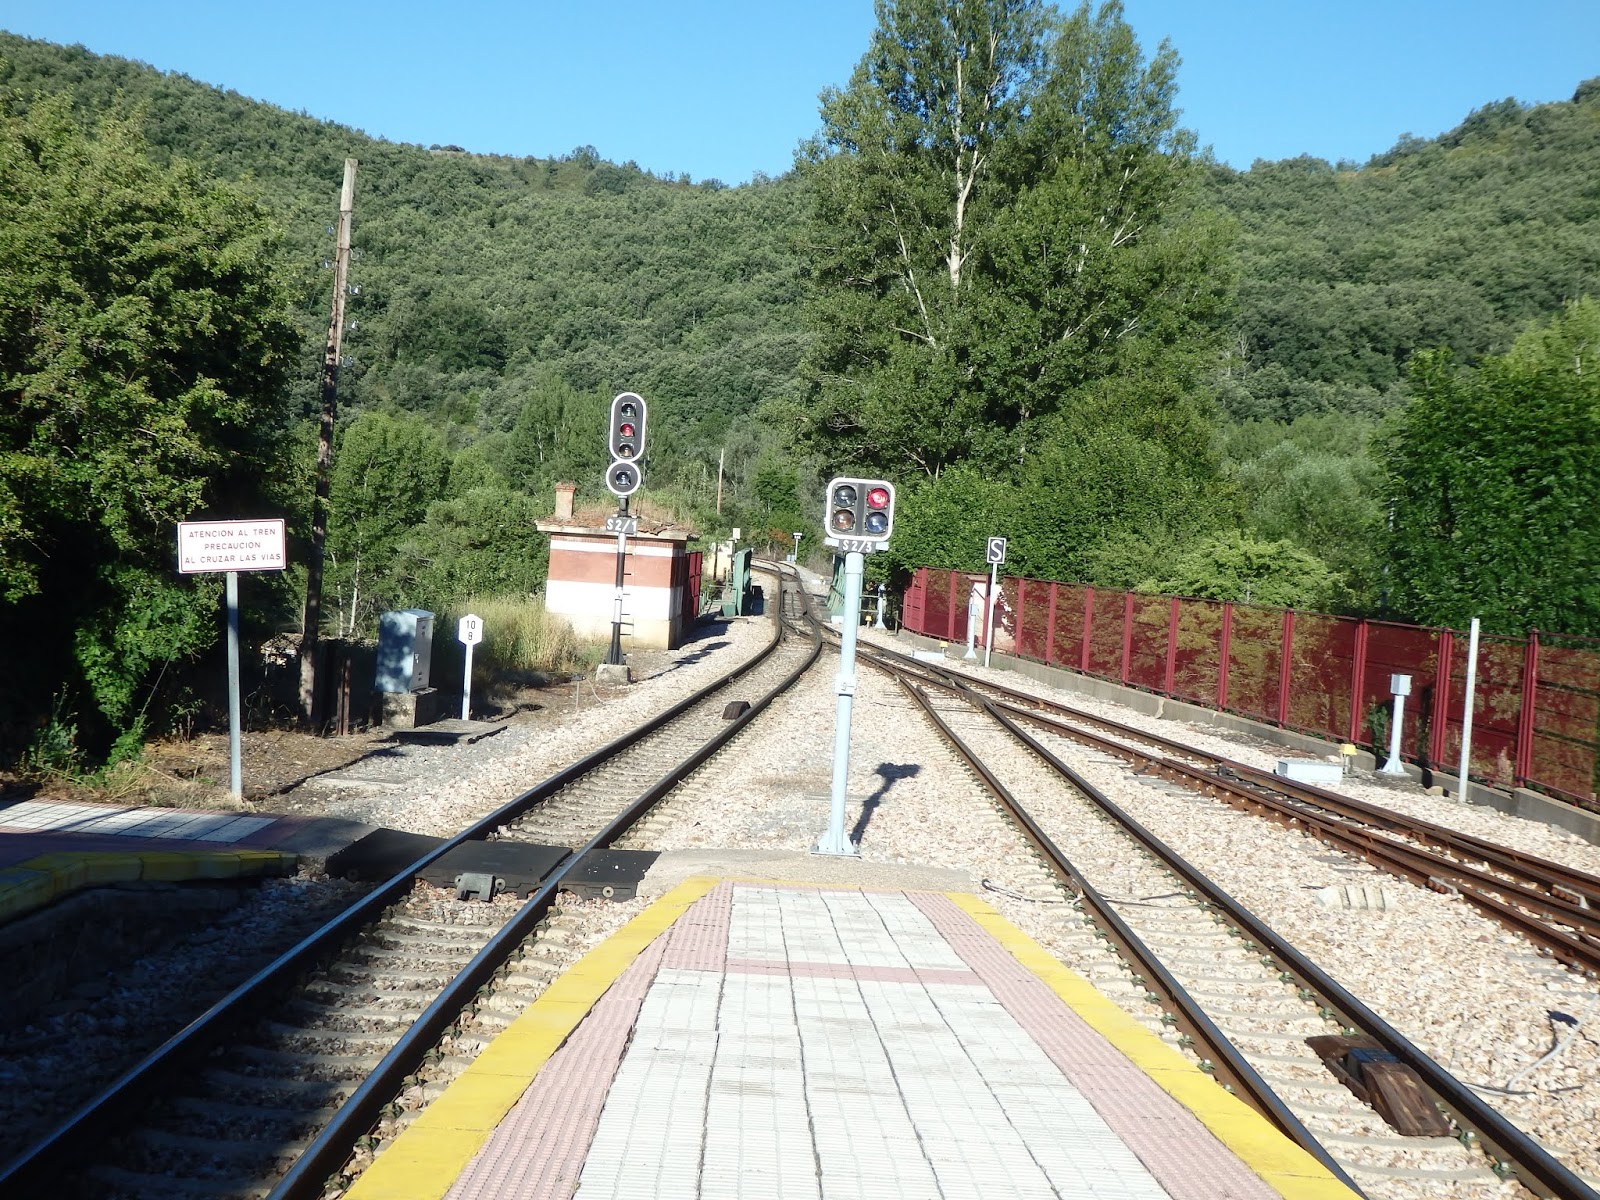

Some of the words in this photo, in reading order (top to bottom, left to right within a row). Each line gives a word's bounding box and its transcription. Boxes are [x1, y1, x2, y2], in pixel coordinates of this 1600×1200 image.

[990, 539, 1003, 561] S
[200, 555, 236, 563] CRUZAR
[240, 554, 257, 562] LAS
[466, 620, 476, 630] 10
[467, 631, 473, 641] 8
